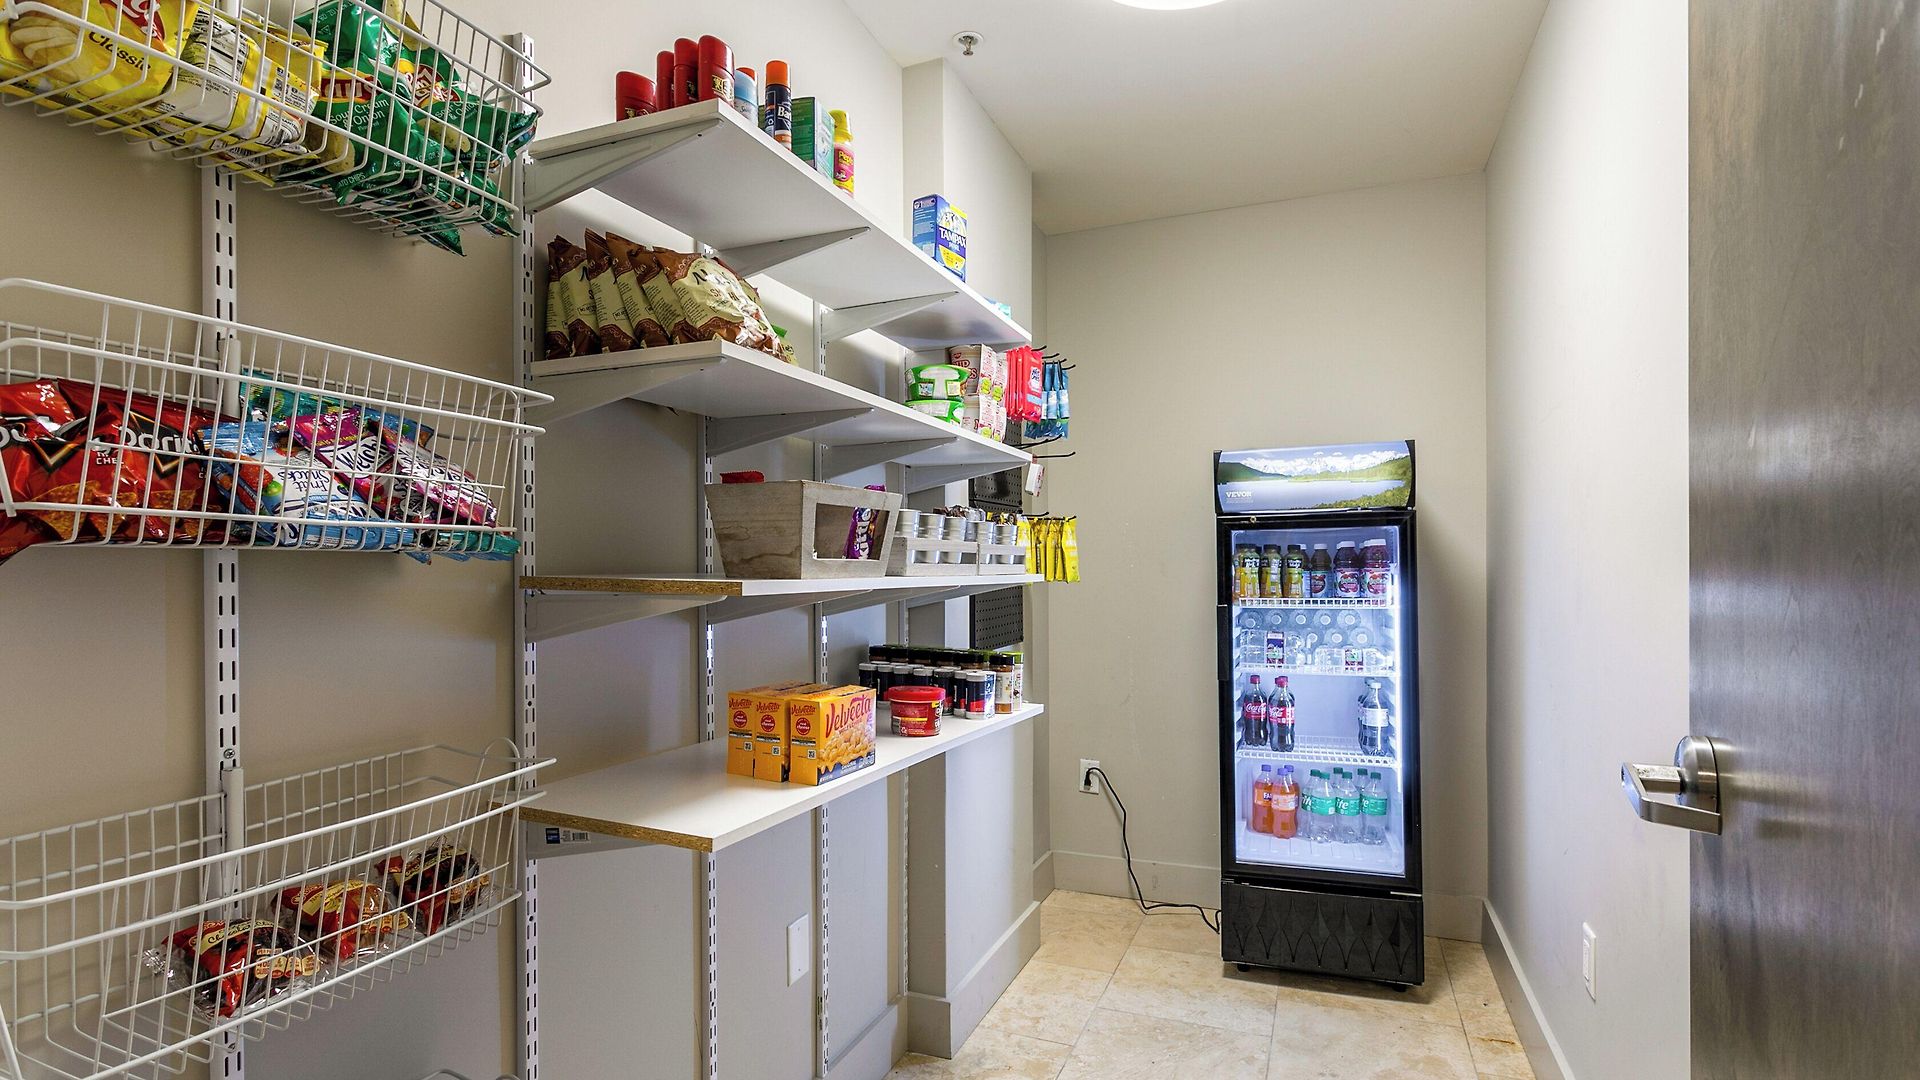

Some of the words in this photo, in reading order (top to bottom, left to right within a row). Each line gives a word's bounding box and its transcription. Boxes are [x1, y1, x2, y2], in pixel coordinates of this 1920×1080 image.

[940, 228, 966, 248] TAMPAX
[116, 426, 201, 454] Dorit
[825, 694, 871, 738] Velveeta
